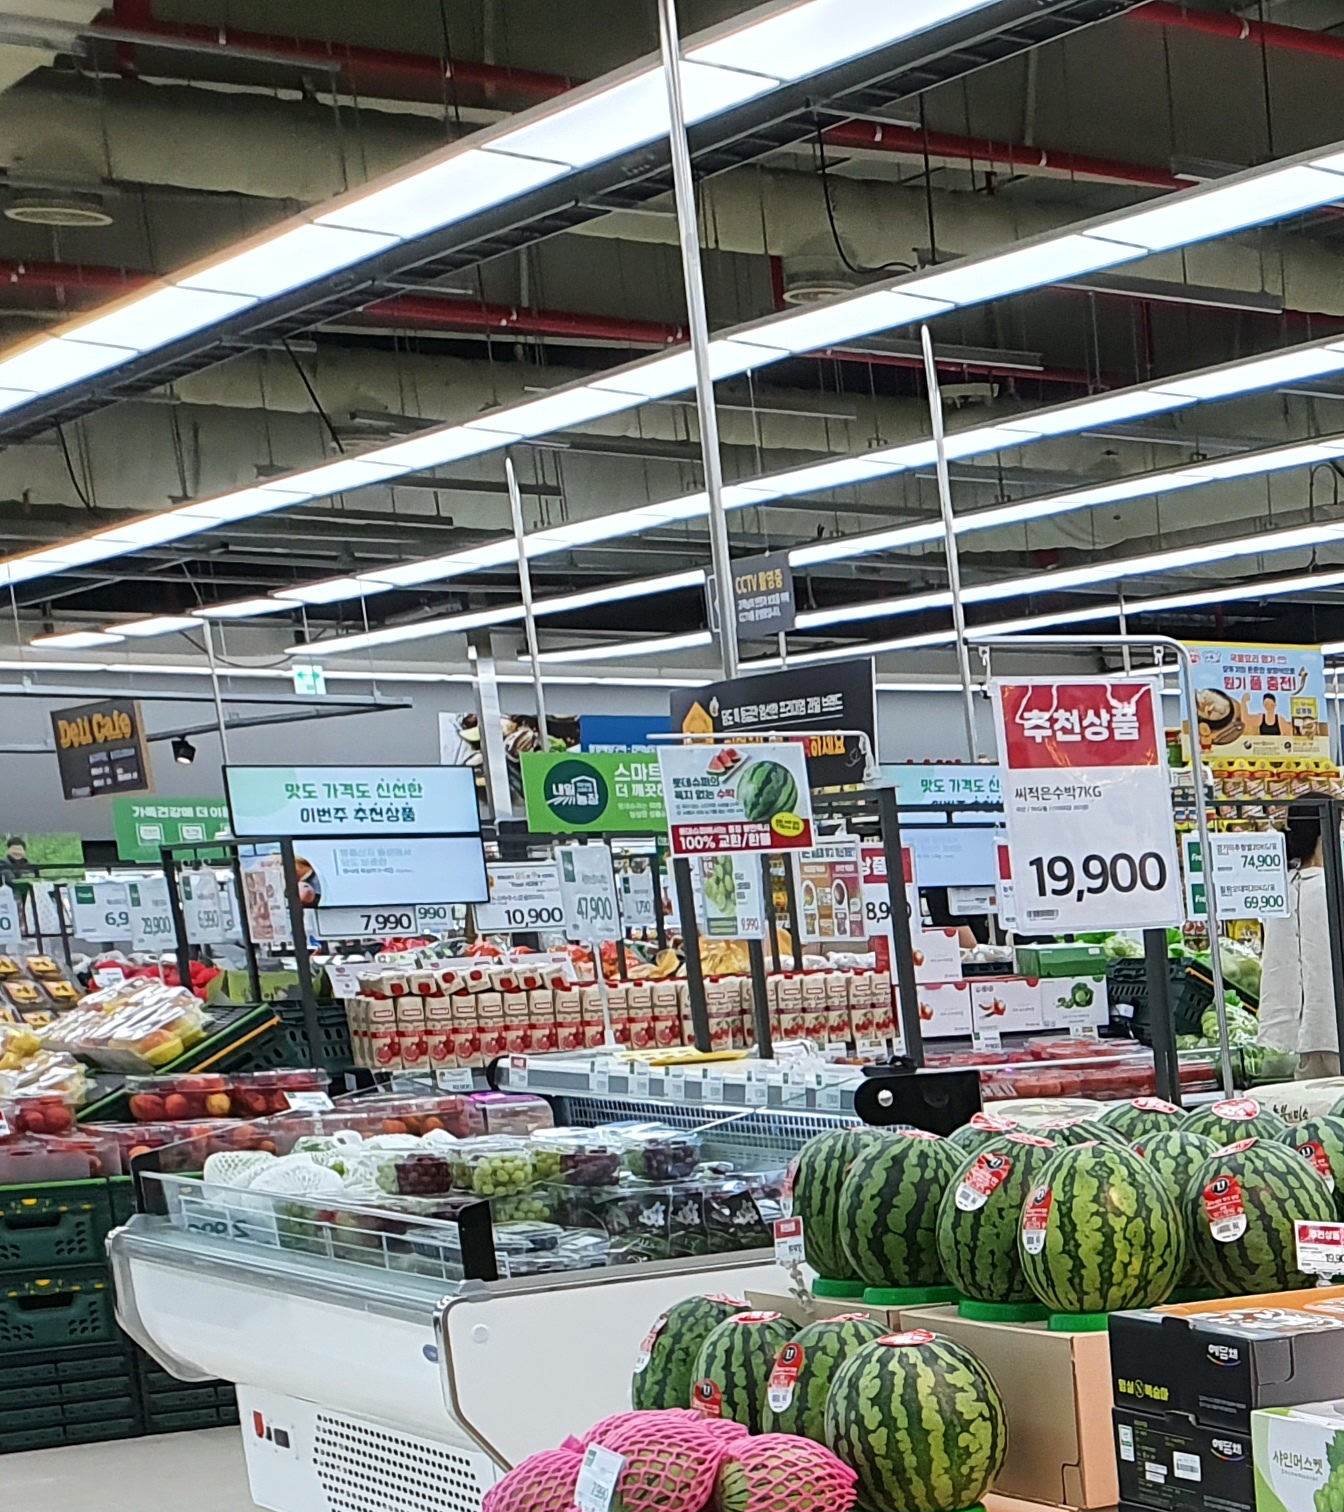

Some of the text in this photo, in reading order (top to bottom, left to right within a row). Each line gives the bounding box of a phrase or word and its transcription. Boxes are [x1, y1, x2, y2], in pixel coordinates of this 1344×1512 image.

[735, 572, 758, 594] CCTV
[58, 710, 132, 749] Deli Cafe
[1021, 702, 1141, 743] 추천상품
[284, 782, 424, 800] 맛도 가격도 신선한
[552, 782, 575, 797] 내일
[615, 786, 628, 799] 더
[920, 776, 986, 796] 맛도 가격도
[1015, 784, 1102, 801] 씨적은수박7KG
[300, 806, 416, 823] 이번주 추천상품
[678, 836, 716, 850] 100%
[1240, 854, 1281, 869] 74,900
[1029, 851, 1168, 902] 19,900
[576, 896, 613, 923] 47,900
[1243, 895, 1284, 910] 69,900
[360, 913, 413, 934] 7,990
[504, 907, 564, 928] 10,900
